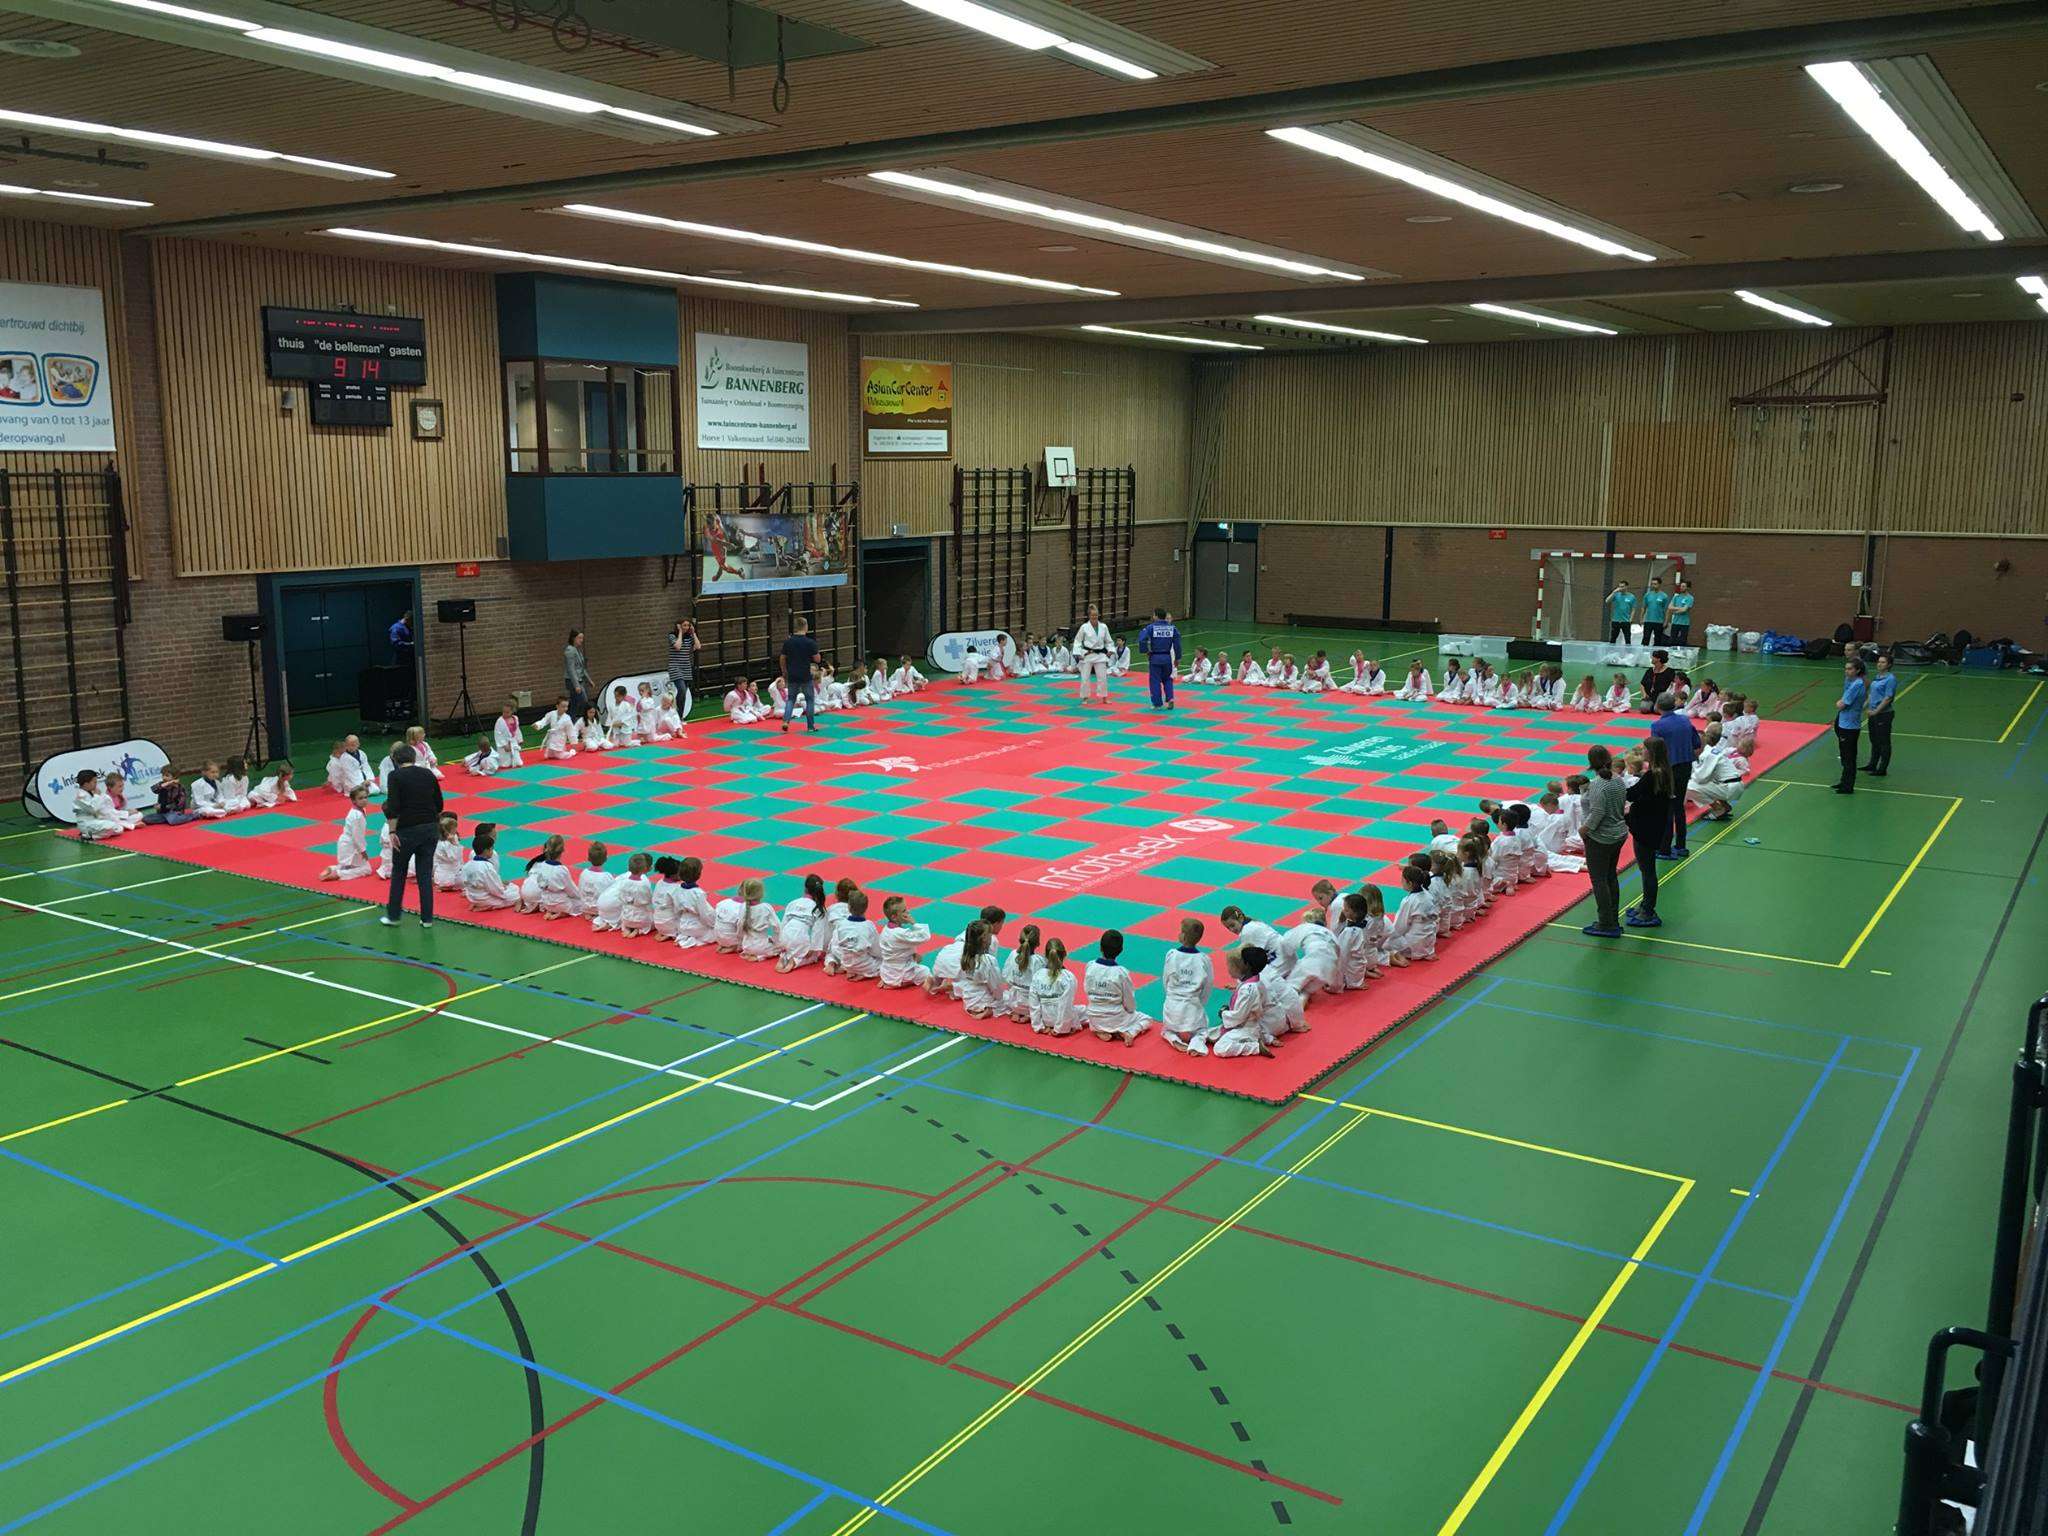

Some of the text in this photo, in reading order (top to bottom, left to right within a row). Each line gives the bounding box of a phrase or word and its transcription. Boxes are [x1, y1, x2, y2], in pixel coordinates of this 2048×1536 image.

[278, 337, 305, 349] thuis
[389, 346, 422, 357] gasten
[334, 357, 380, 379] 9 14
[725, 377, 804, 395] BANNENBERG
[31, 416, 50, 425] van
[52, 416, 59, 425] 0
[61, 417, 76, 425] tot
[79, 416, 90, 425] 13
[92, 417, 110, 428] jaar
[1014, 833, 1197, 889] Infotheek
